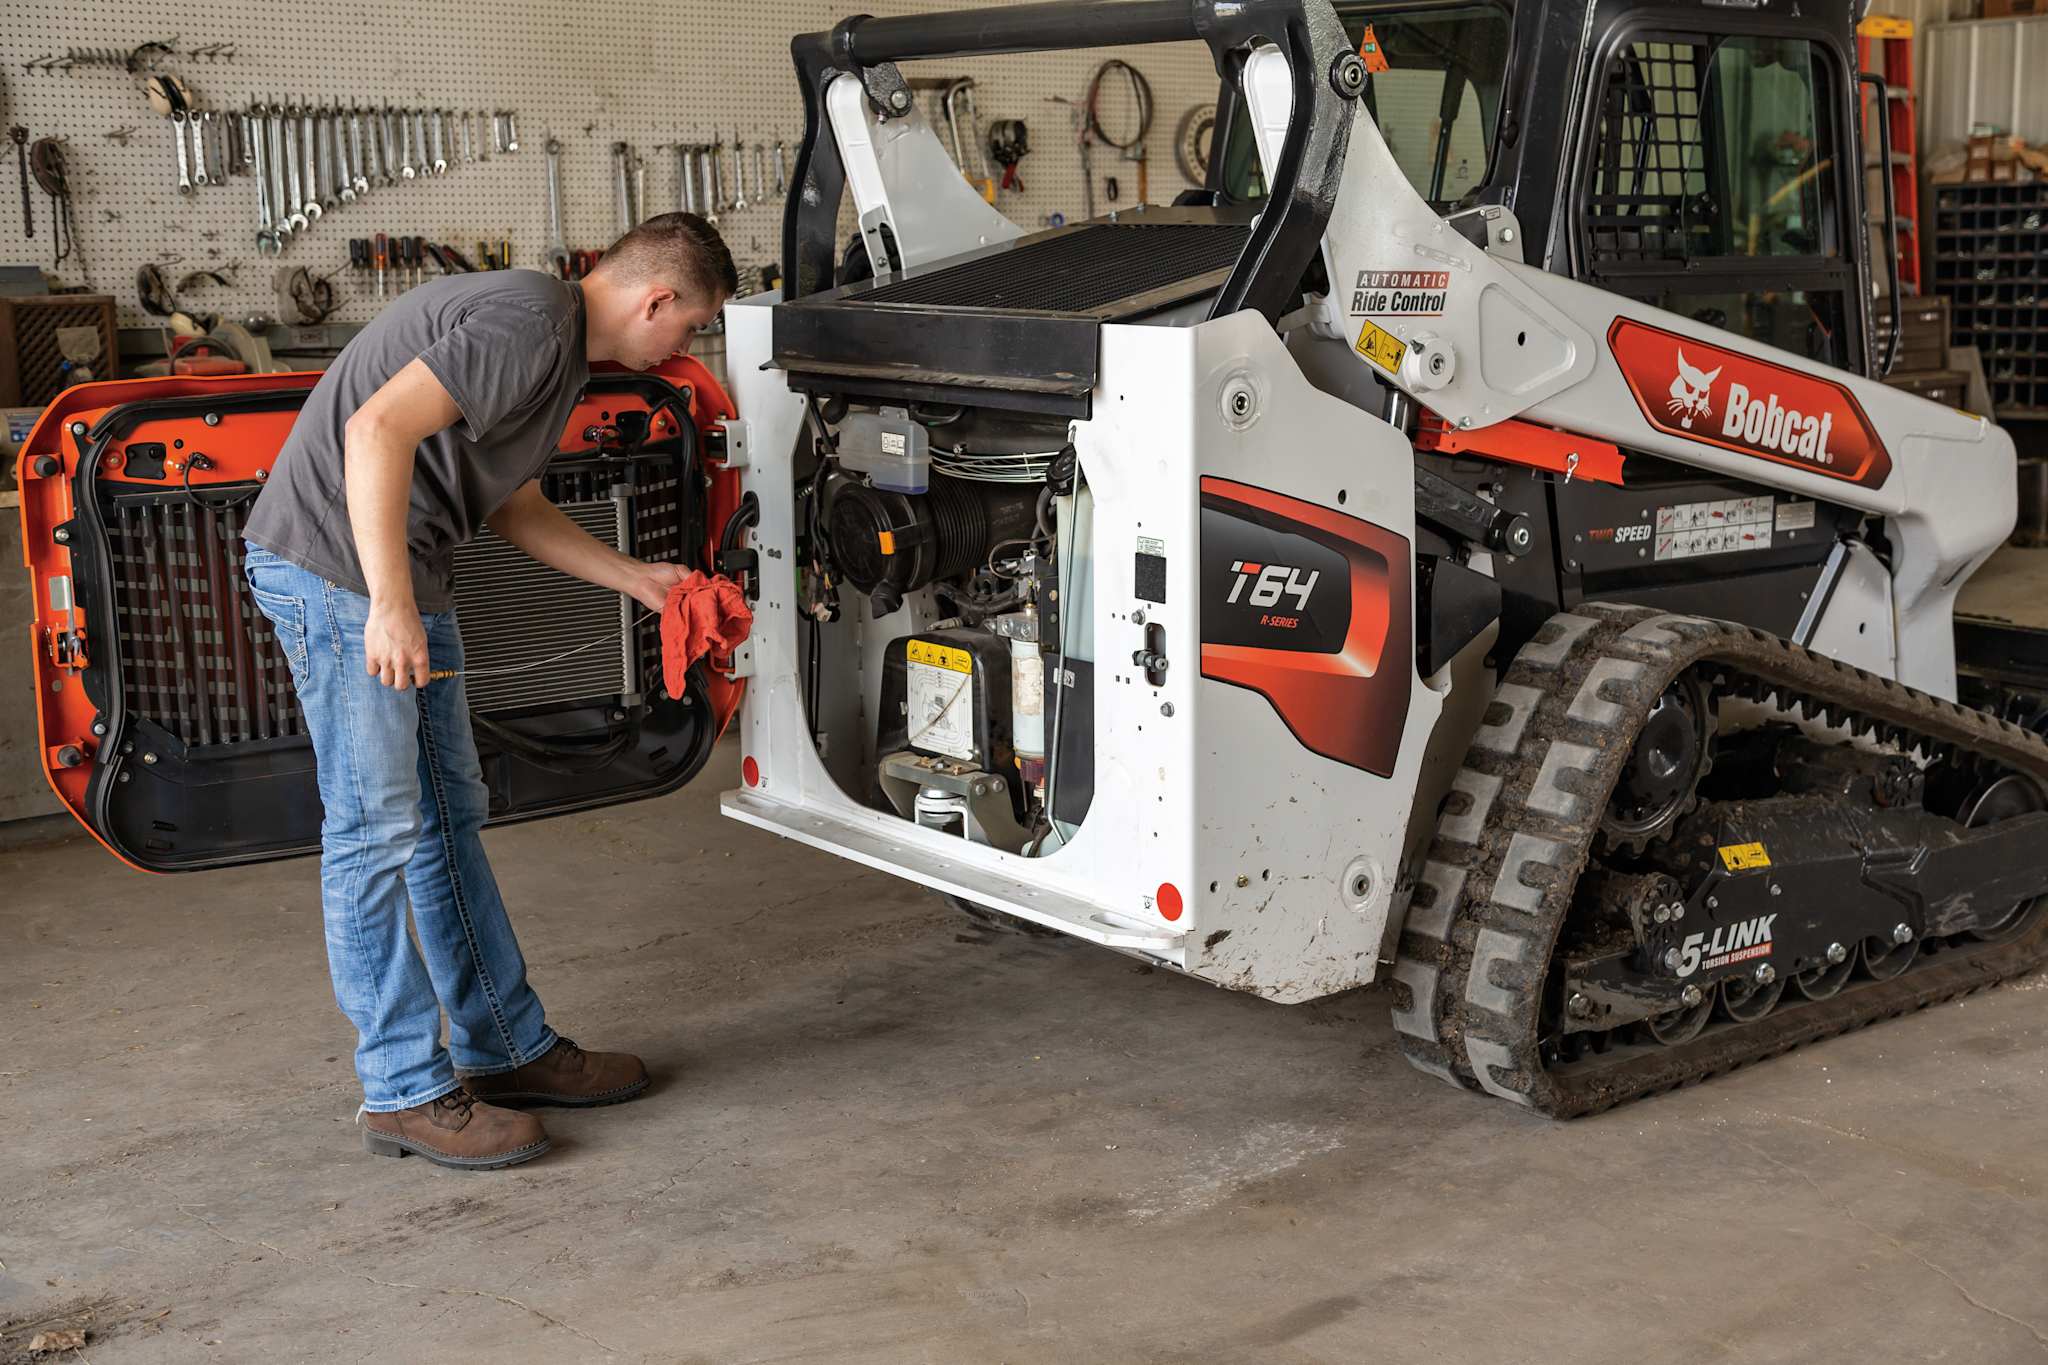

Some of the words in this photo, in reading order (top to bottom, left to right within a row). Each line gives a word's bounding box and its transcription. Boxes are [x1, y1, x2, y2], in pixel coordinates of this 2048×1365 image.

[1359, 273, 1448, 288] AUTOMATIC
[1351, 291, 1388, 312] Ride
[1390, 291, 1447, 312] Control
[1721, 382, 1833, 463] Bobcat
[1615, 525, 1652, 543] SPEED
[1227, 561, 1320, 611] T64
[1260, 614, 1299, 629] R-SERIES
[1676, 913, 1778, 977] 5-LINK
[1702, 954, 1730, 970] TORSION
[1730, 943, 1772, 963] SUSPENSION
